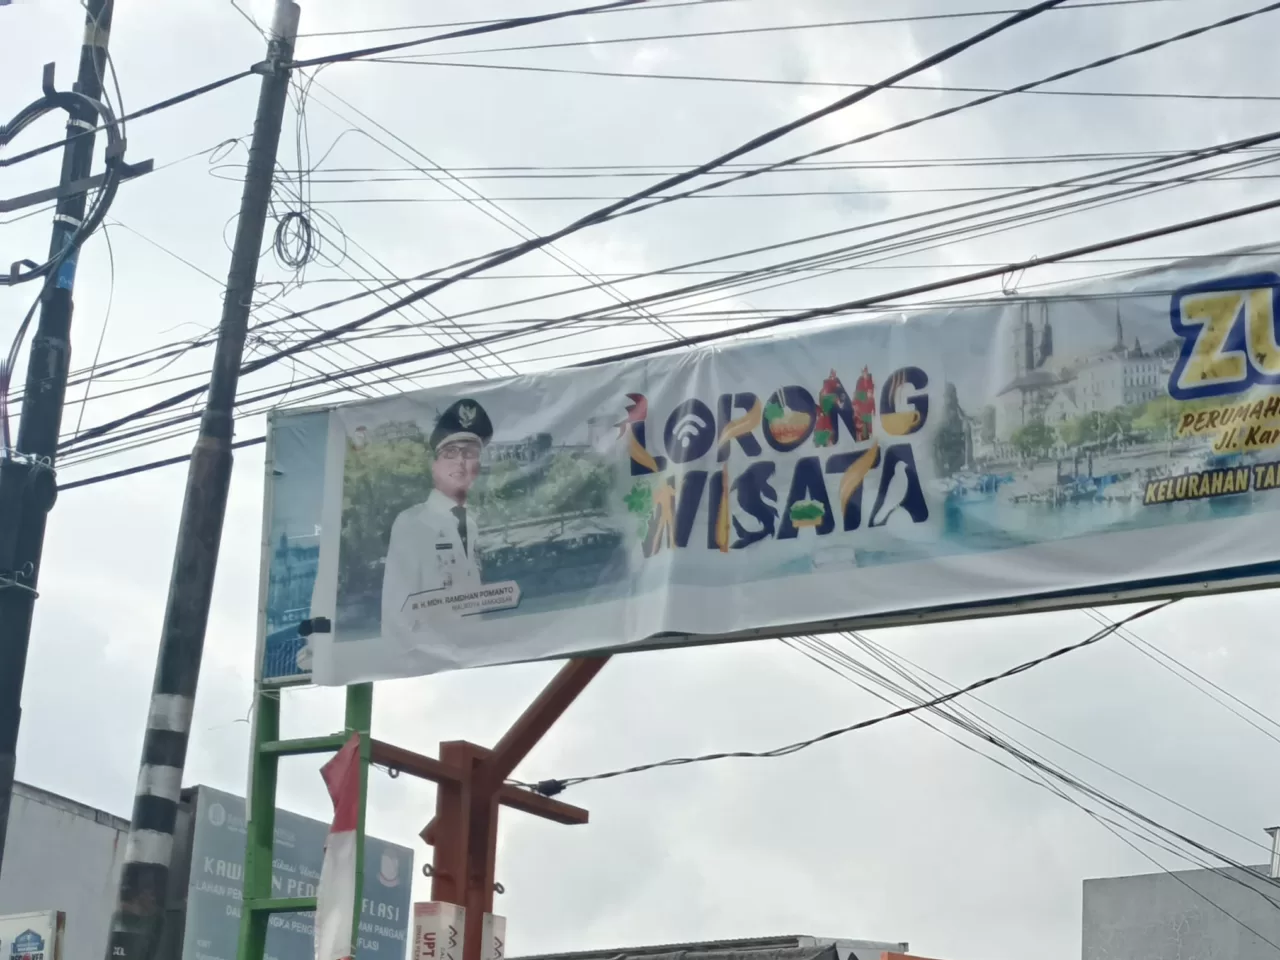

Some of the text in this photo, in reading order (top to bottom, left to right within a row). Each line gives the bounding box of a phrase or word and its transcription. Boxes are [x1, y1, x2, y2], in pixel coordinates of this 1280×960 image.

[615, 364, 930, 476] LORONG
[1214, 429, 1238, 451] Jl.
[624, 438, 930, 558] WISATA
[1144, 467, 1250, 505] KELURAHAN
[480, 586, 514, 598] POMANTO
[423, 931, 436, 958] UPT
